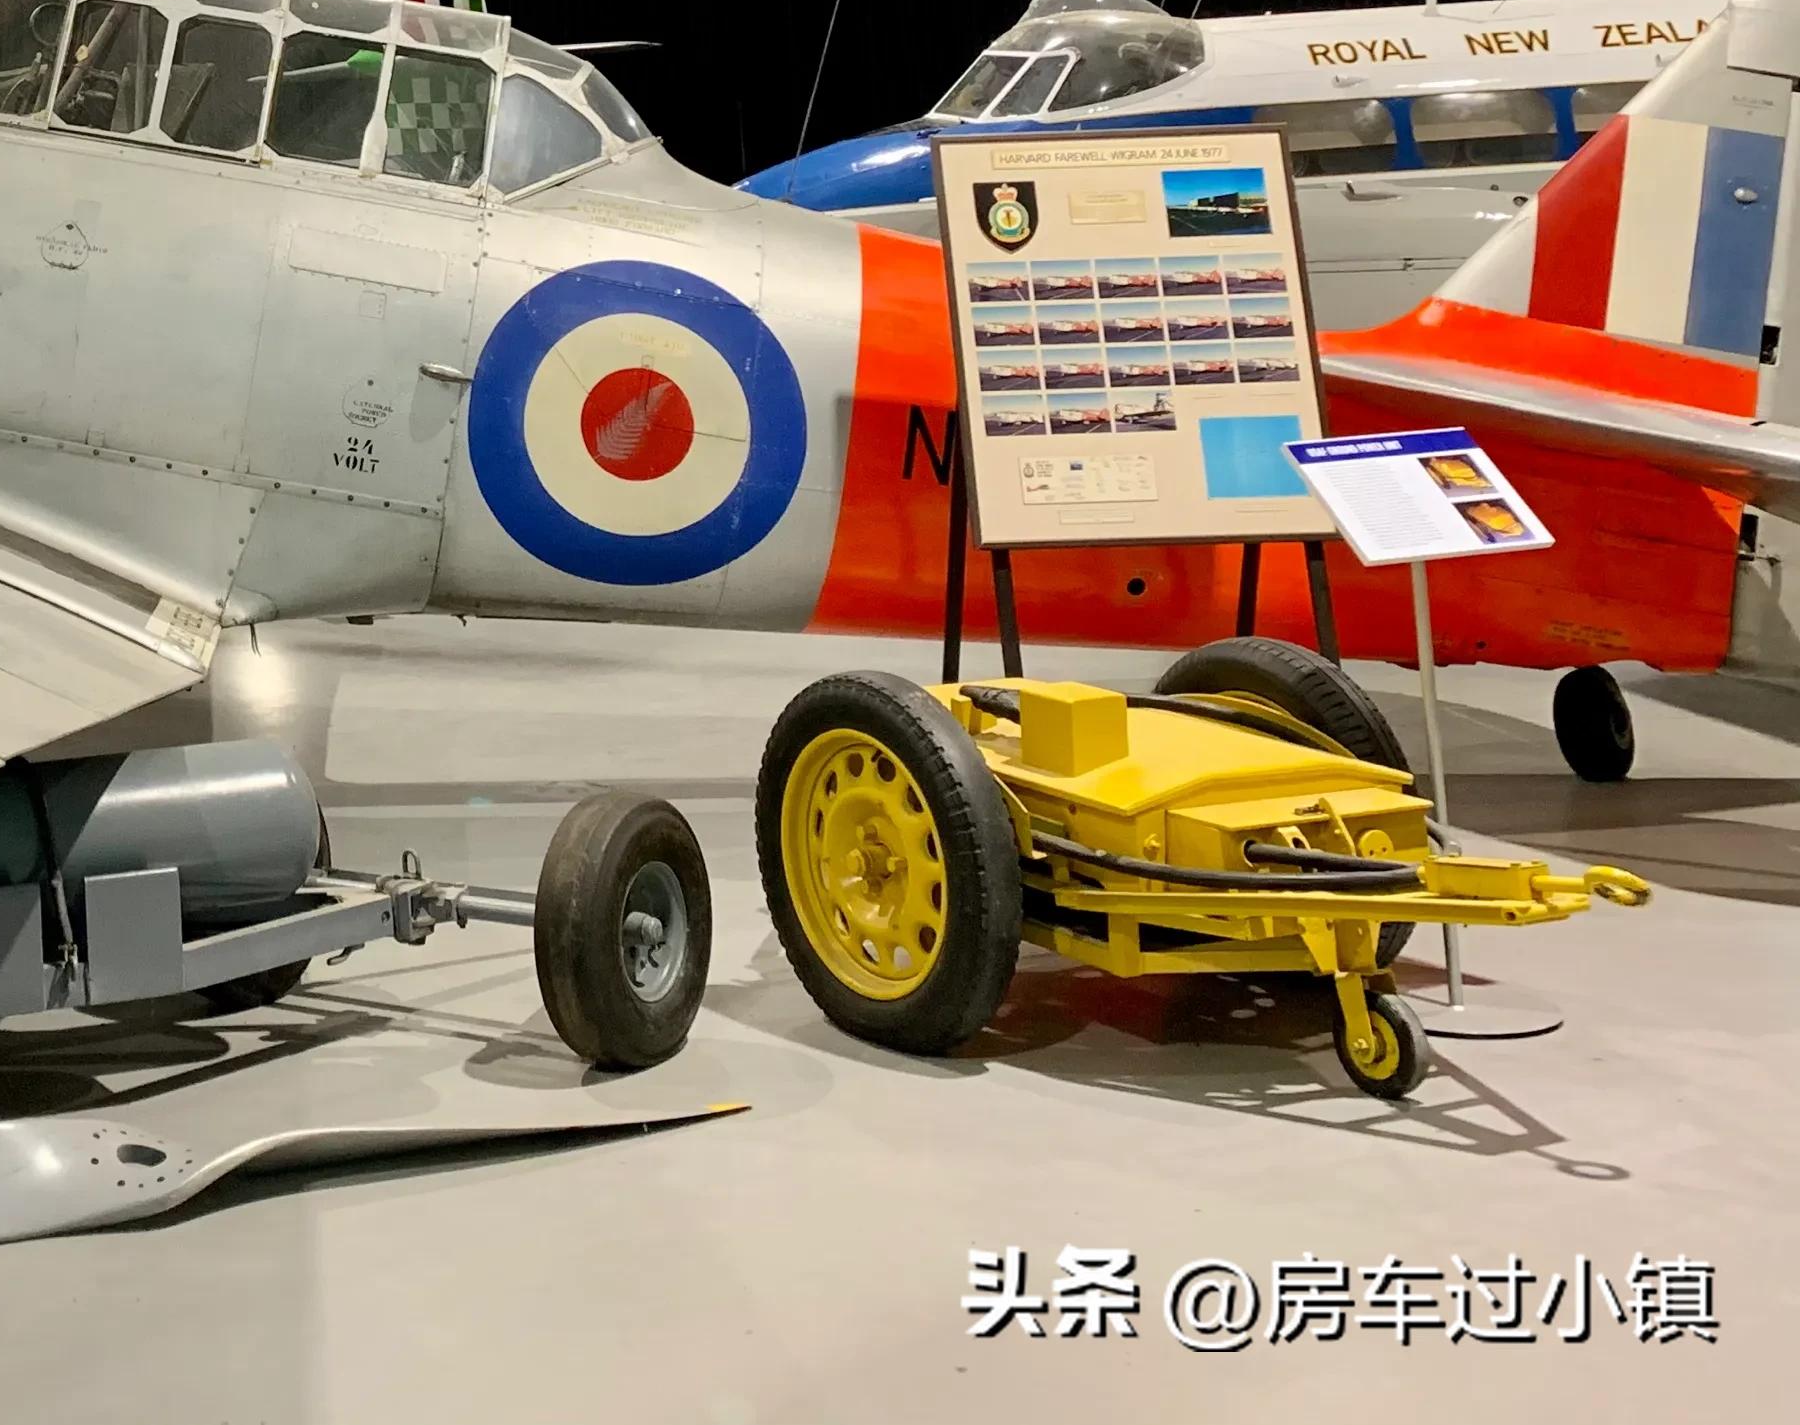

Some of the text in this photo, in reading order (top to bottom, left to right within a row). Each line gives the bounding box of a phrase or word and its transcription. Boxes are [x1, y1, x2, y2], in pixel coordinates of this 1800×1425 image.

[1307, 37, 1426, 66] ROYAL
[1464, 29, 1551, 56] NEW
[1000, 153, 1050, 164] HARVARD
[1055, 150, 1107, 162] FAREWELL
[1111, 149, 1156, 161] WIGRAM
[1160, 149, 1172, 159] 24
[1175, 148, 1198, 159] JUNE
[347, 437, 374, 455] 24
[333, 452, 380, 474] VOLT
